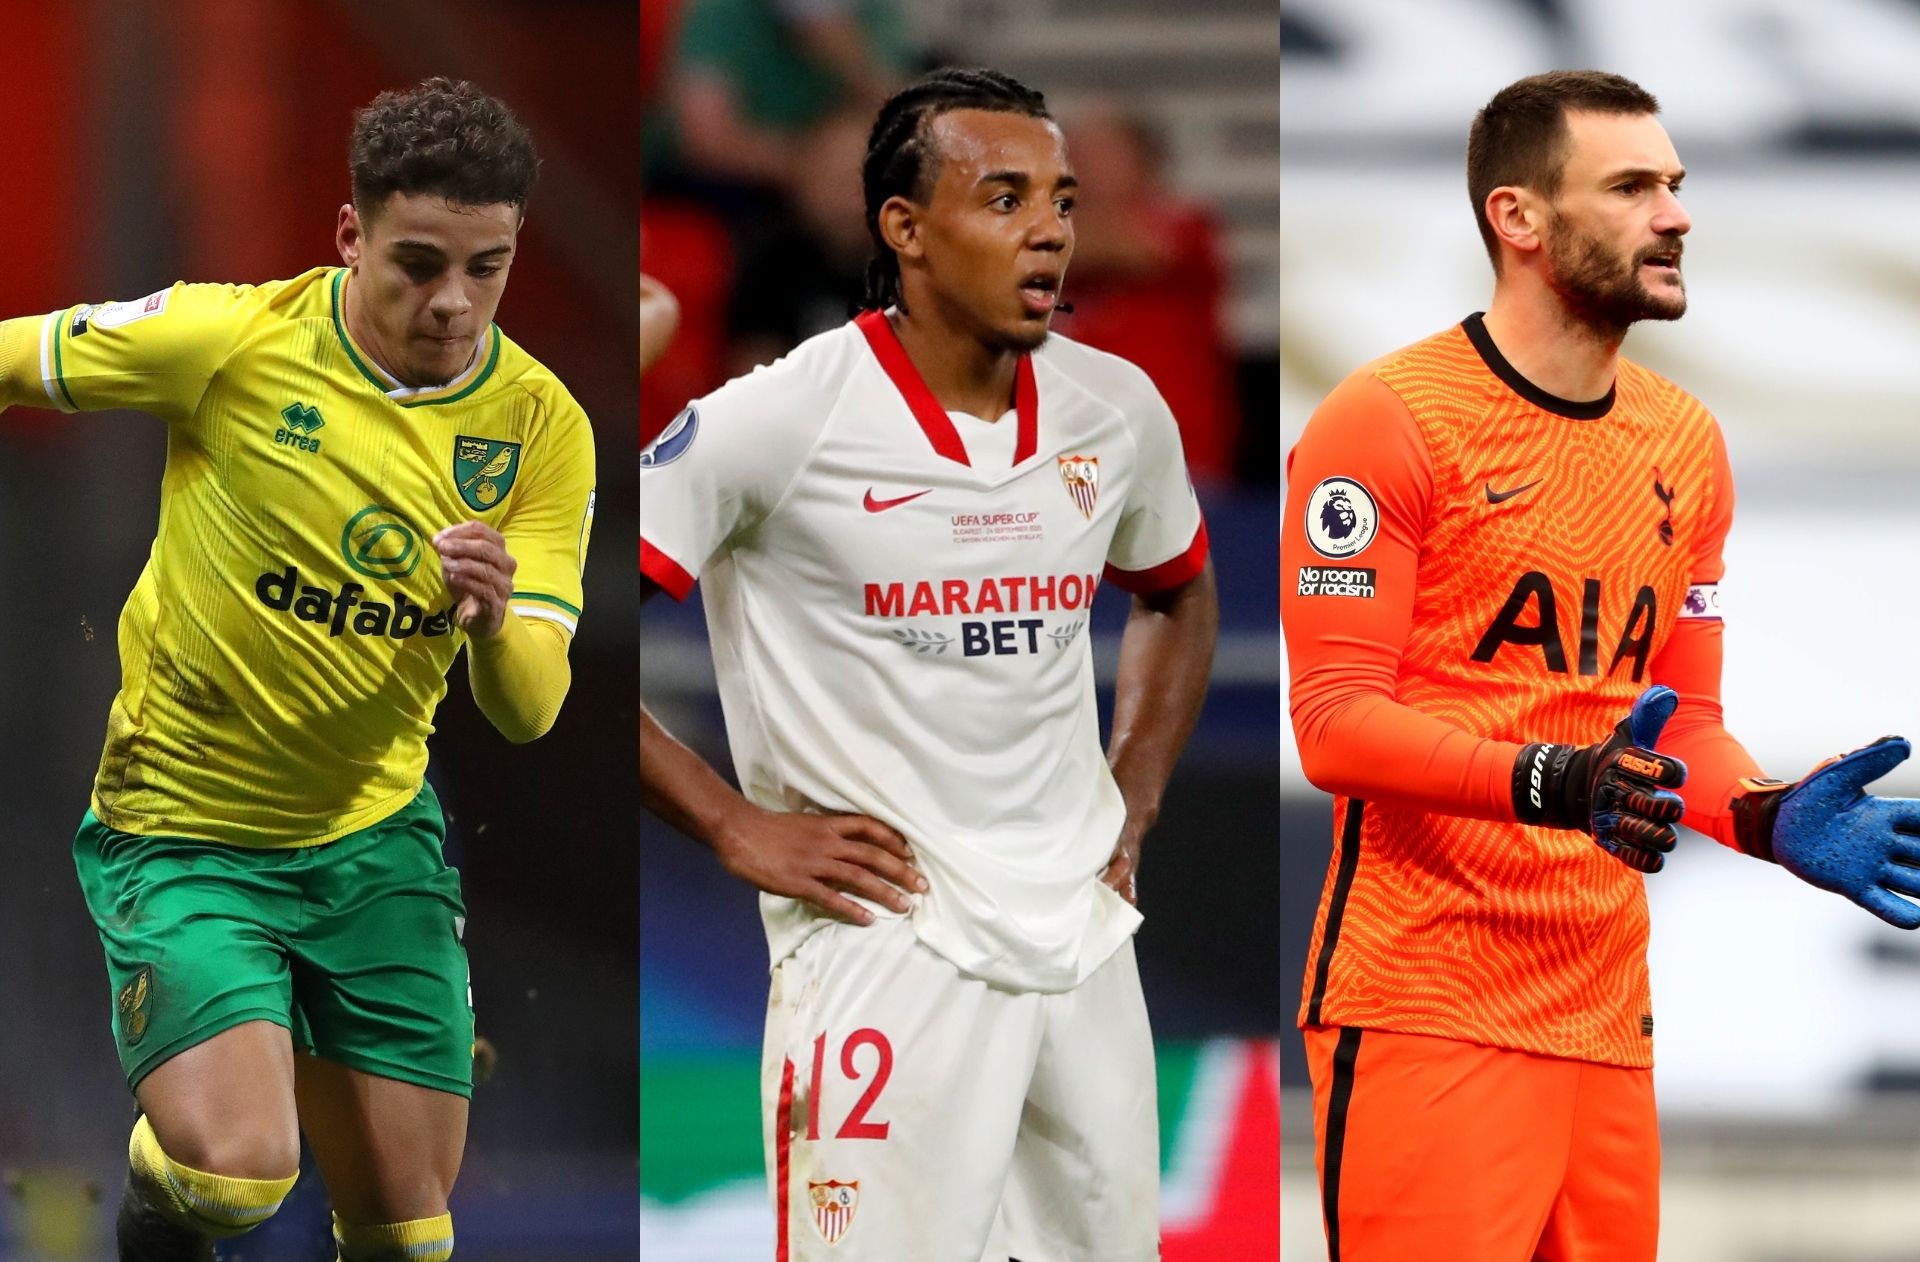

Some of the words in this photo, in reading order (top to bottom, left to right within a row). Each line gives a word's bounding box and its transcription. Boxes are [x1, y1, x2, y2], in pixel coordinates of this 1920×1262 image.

[274, 428, 321, 453] errea
[951, 515, 980, 526] UEFA
[982, 513, 1015, 526] SUPER
[1332, 539, 1357, 551] Premier
[1354, 517, 1369, 542] League
[1297, 581, 1319, 596] for
[1319, 582, 1375, 598] racism
[1299, 567, 1320, 582] No
[1322, 568, 1368, 584] room
[961, 619, 1044, 657] BET
[1469, 570, 1657, 684] AIA
[1530, 743, 1555, 809] HUGO
[1617, 753, 1665, 778] reusch
[806, 1027, 894, 1141] 12
